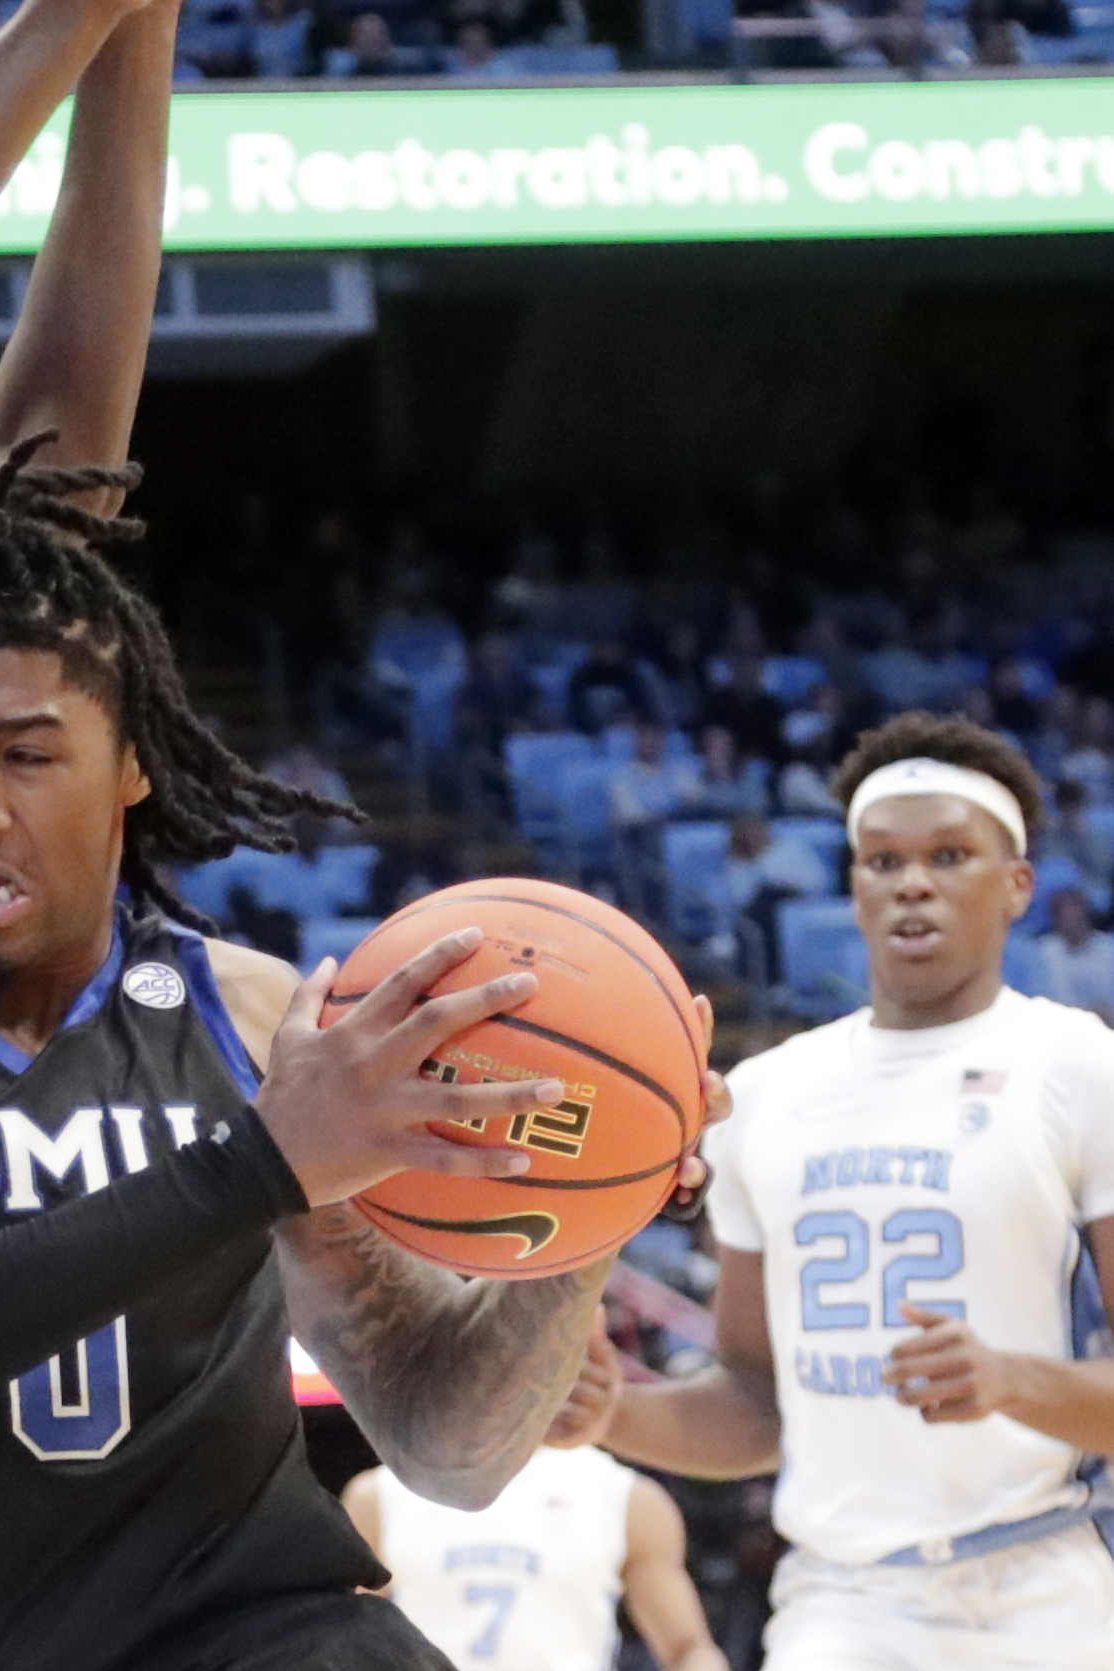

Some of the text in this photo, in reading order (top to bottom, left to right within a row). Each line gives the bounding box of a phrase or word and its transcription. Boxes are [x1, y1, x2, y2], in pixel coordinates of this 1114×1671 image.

[227, 123, 789, 212] Restoration.
[131, 976, 177, 993] ACC
[800, 1145, 953, 1196] NORTH
[794, 1206, 968, 1332] 22
[465, 1585, 517, 1658] 7
